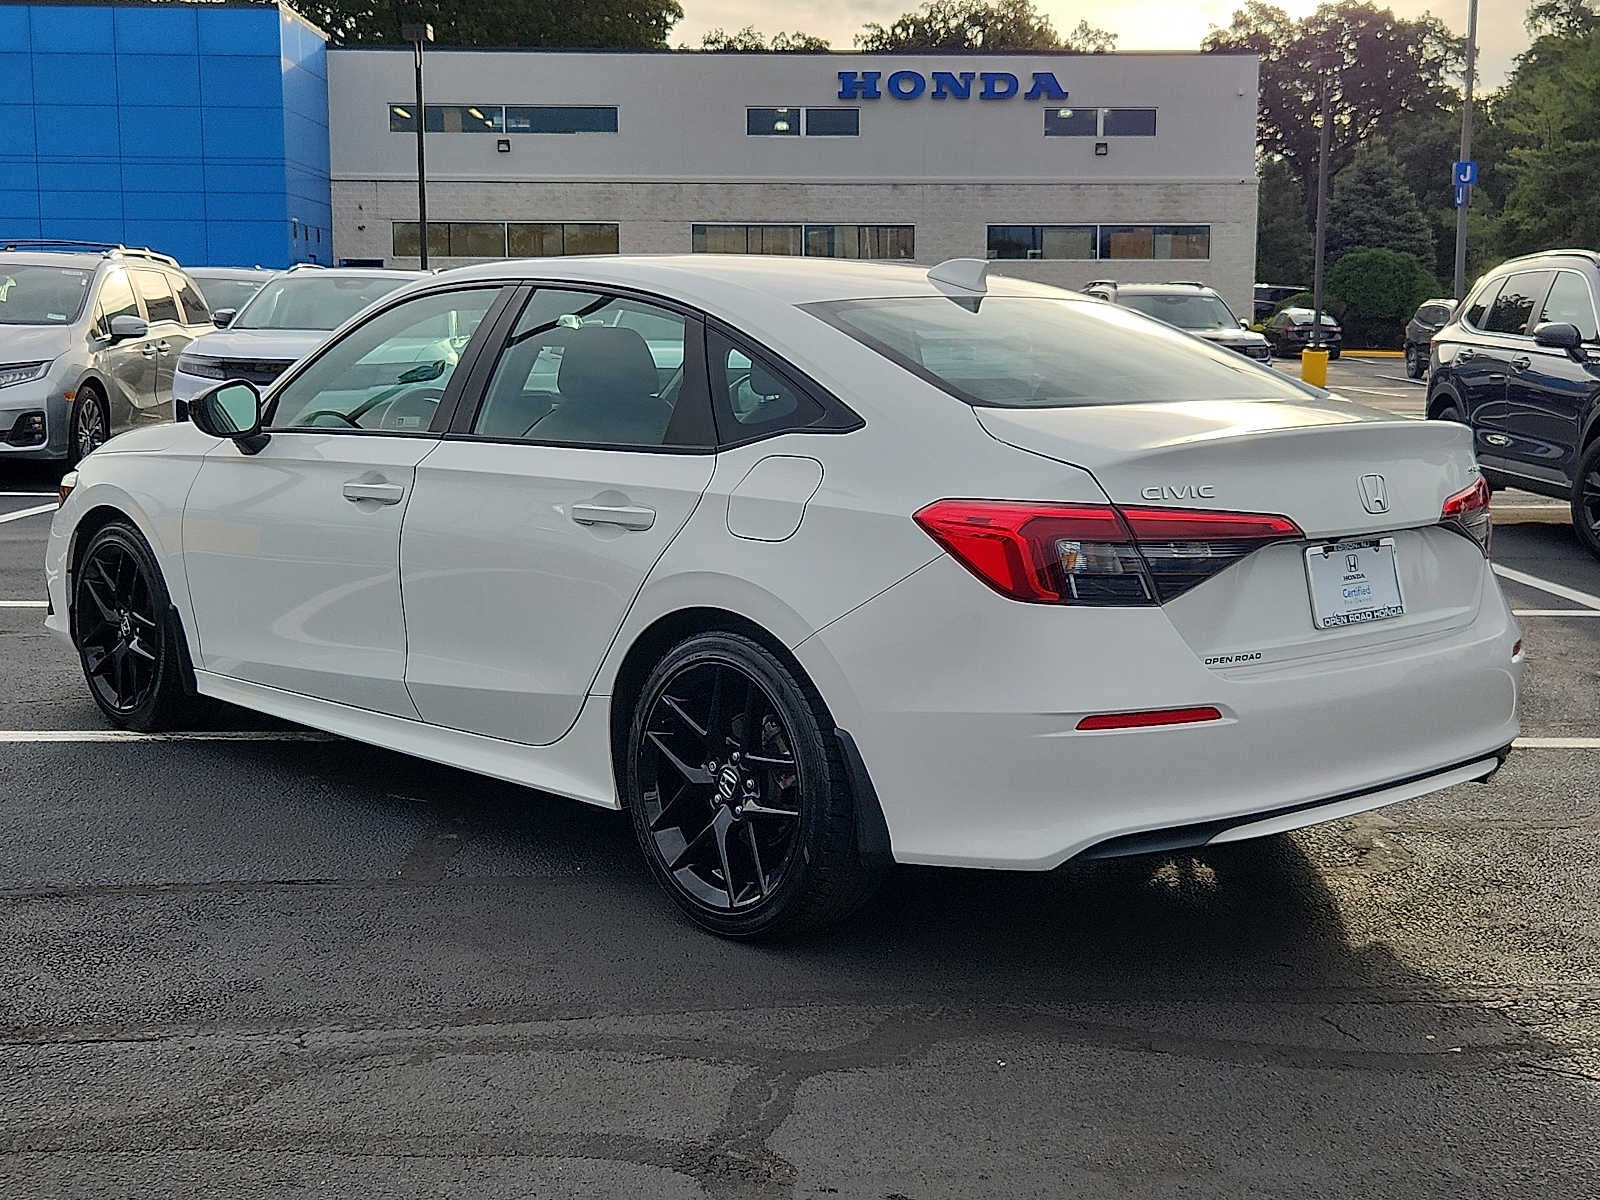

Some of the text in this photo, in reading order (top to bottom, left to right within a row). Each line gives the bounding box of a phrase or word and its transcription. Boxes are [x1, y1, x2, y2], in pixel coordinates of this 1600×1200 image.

[837, 70, 1069, 100] HONDA
[1460, 165, 1471, 182] J
[1141, 485, 1216, 500] CIVIC
[1343, 573, 1366, 581] HONDA
[1342, 585, 1371, 598] Certified
[1324, 614, 1347, 626] OPEN
[1349, 611, 1372, 623] ROAD
[1374, 606, 1403, 618] HONDA
[1204, 652, 1262, 665] OPEN ROAD
